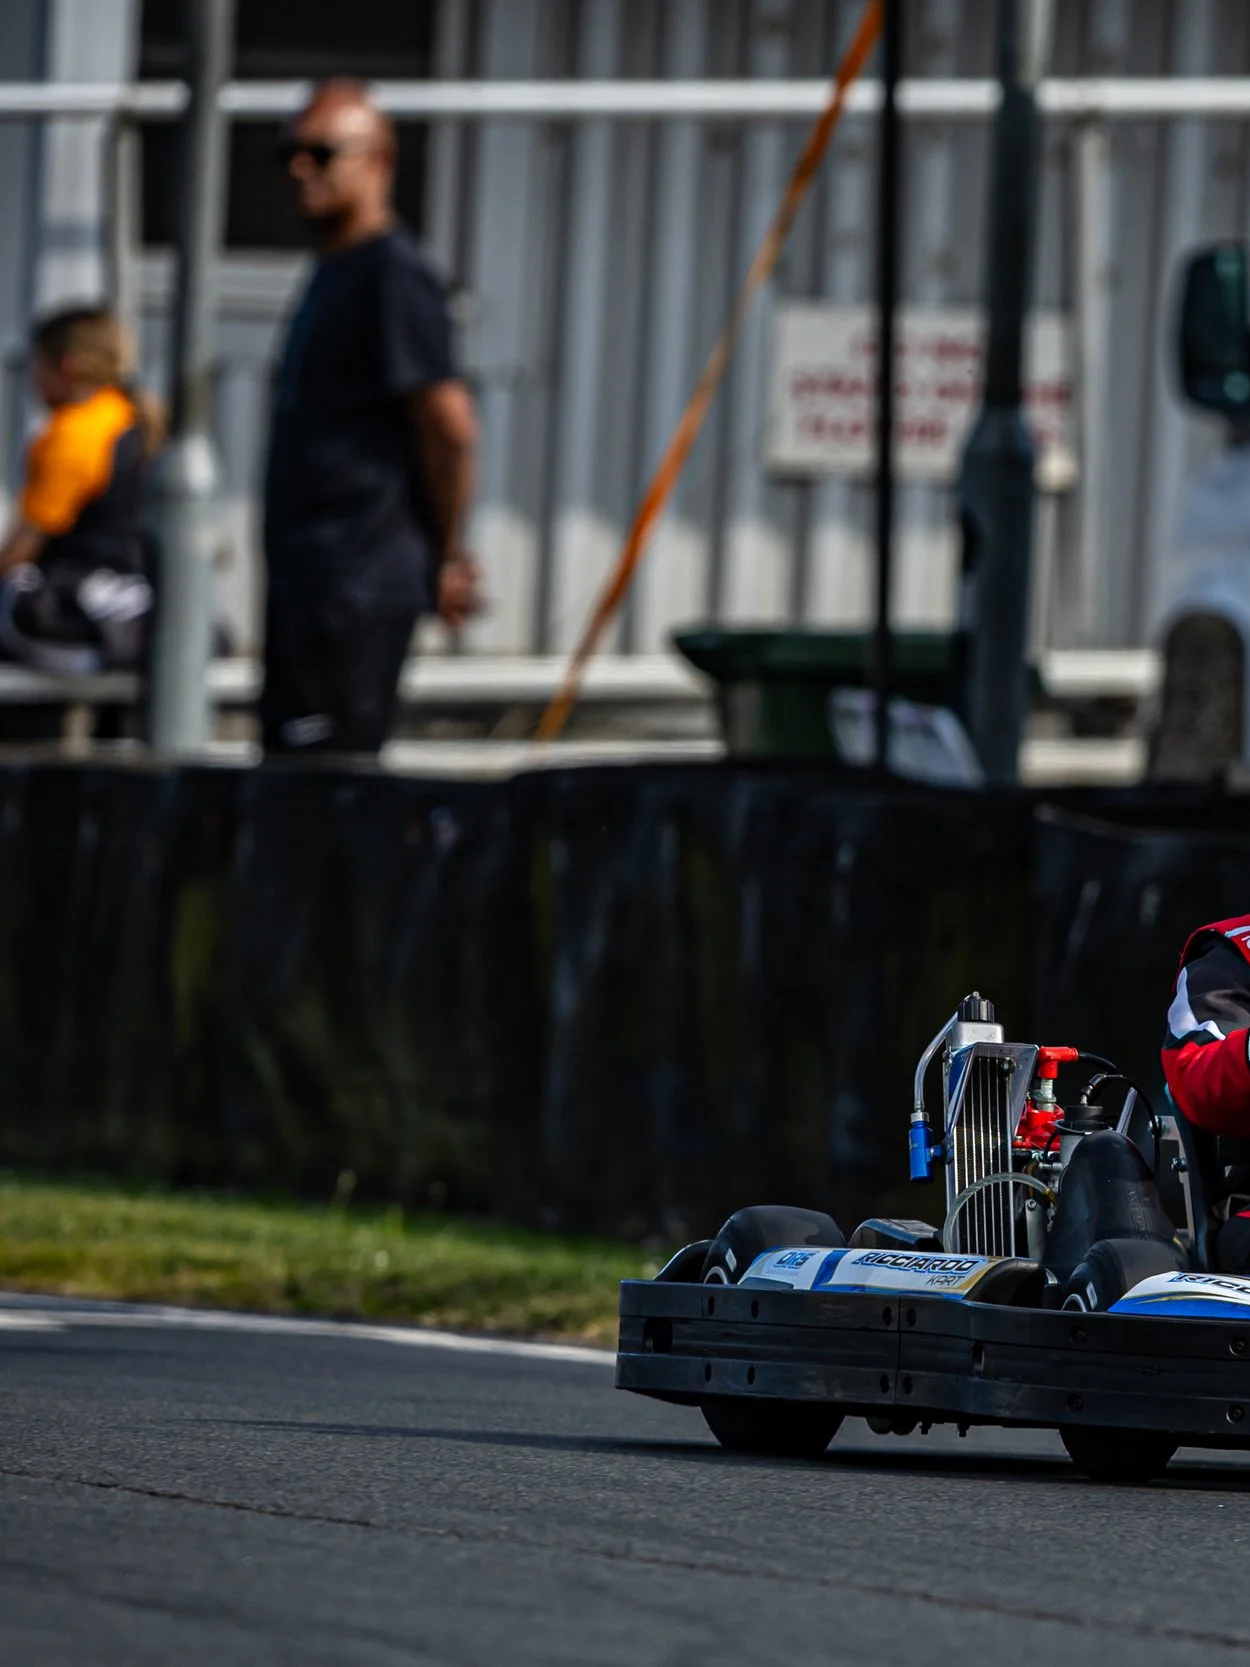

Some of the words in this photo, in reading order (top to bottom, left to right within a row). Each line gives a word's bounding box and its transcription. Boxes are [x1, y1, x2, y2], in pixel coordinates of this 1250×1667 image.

[775, 1252, 813, 1269] DRS
[852, 1251, 981, 1275] RICCIARDO
[926, 1275, 965, 1287] KART
